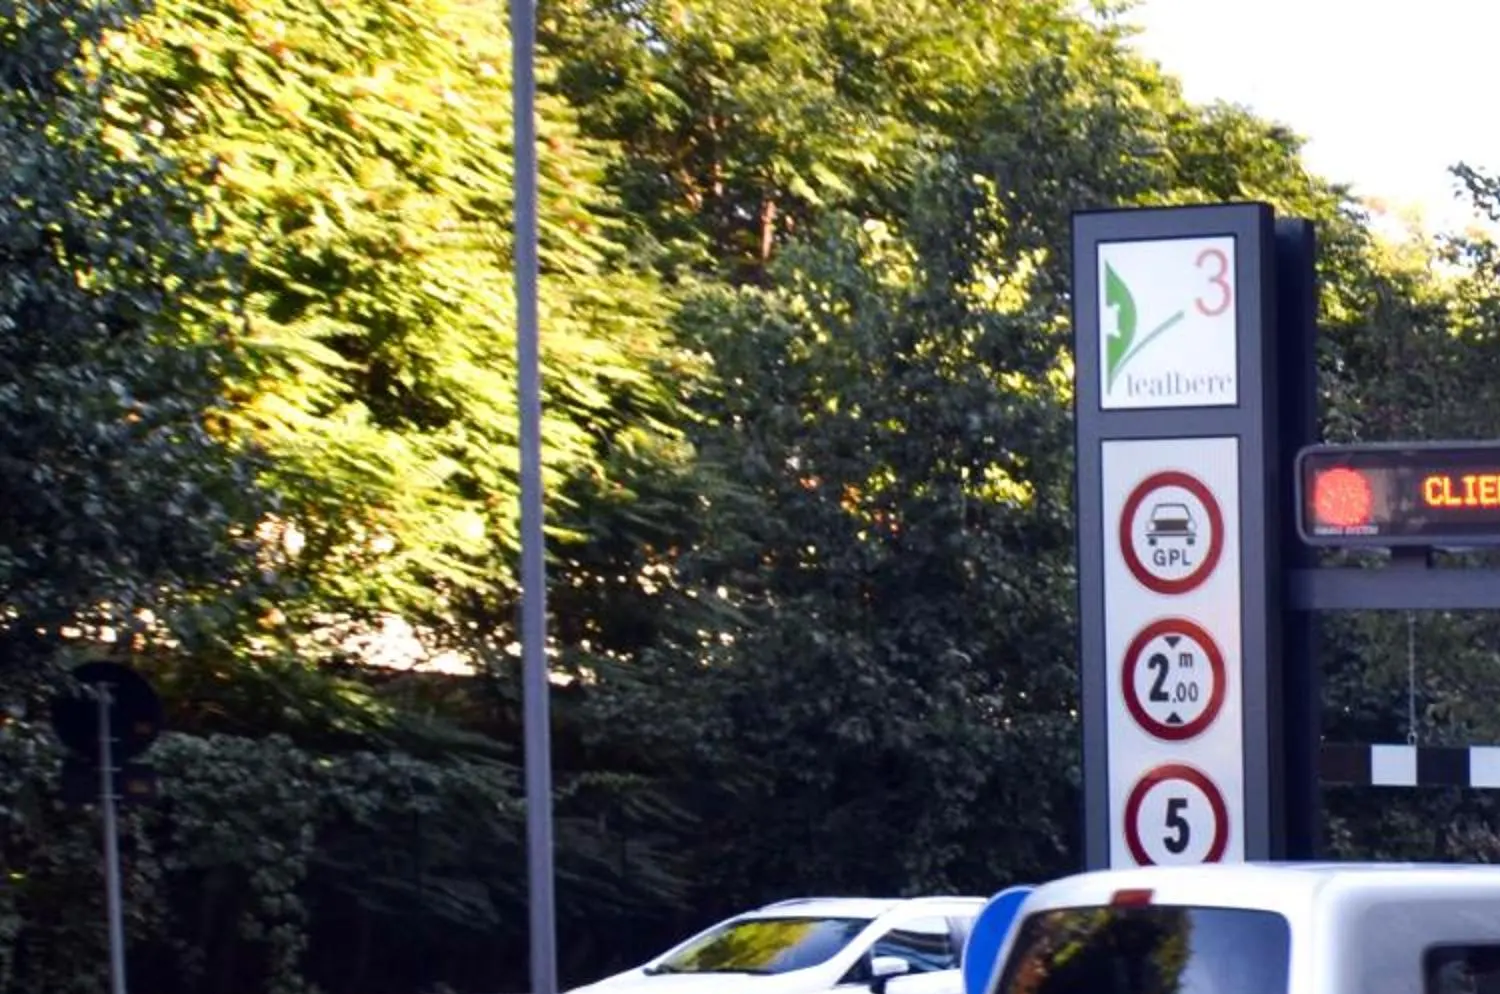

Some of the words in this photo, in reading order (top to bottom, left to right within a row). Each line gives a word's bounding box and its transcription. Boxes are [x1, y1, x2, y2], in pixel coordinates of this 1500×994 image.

[1195, 247, 1232, 317] 3
[1153, 549, 1192, 567] GPL
[1147, 653, 1170, 702] 2
[1178, 652, 1193, 668] m
[1163, 797, 1190, 854] 5
